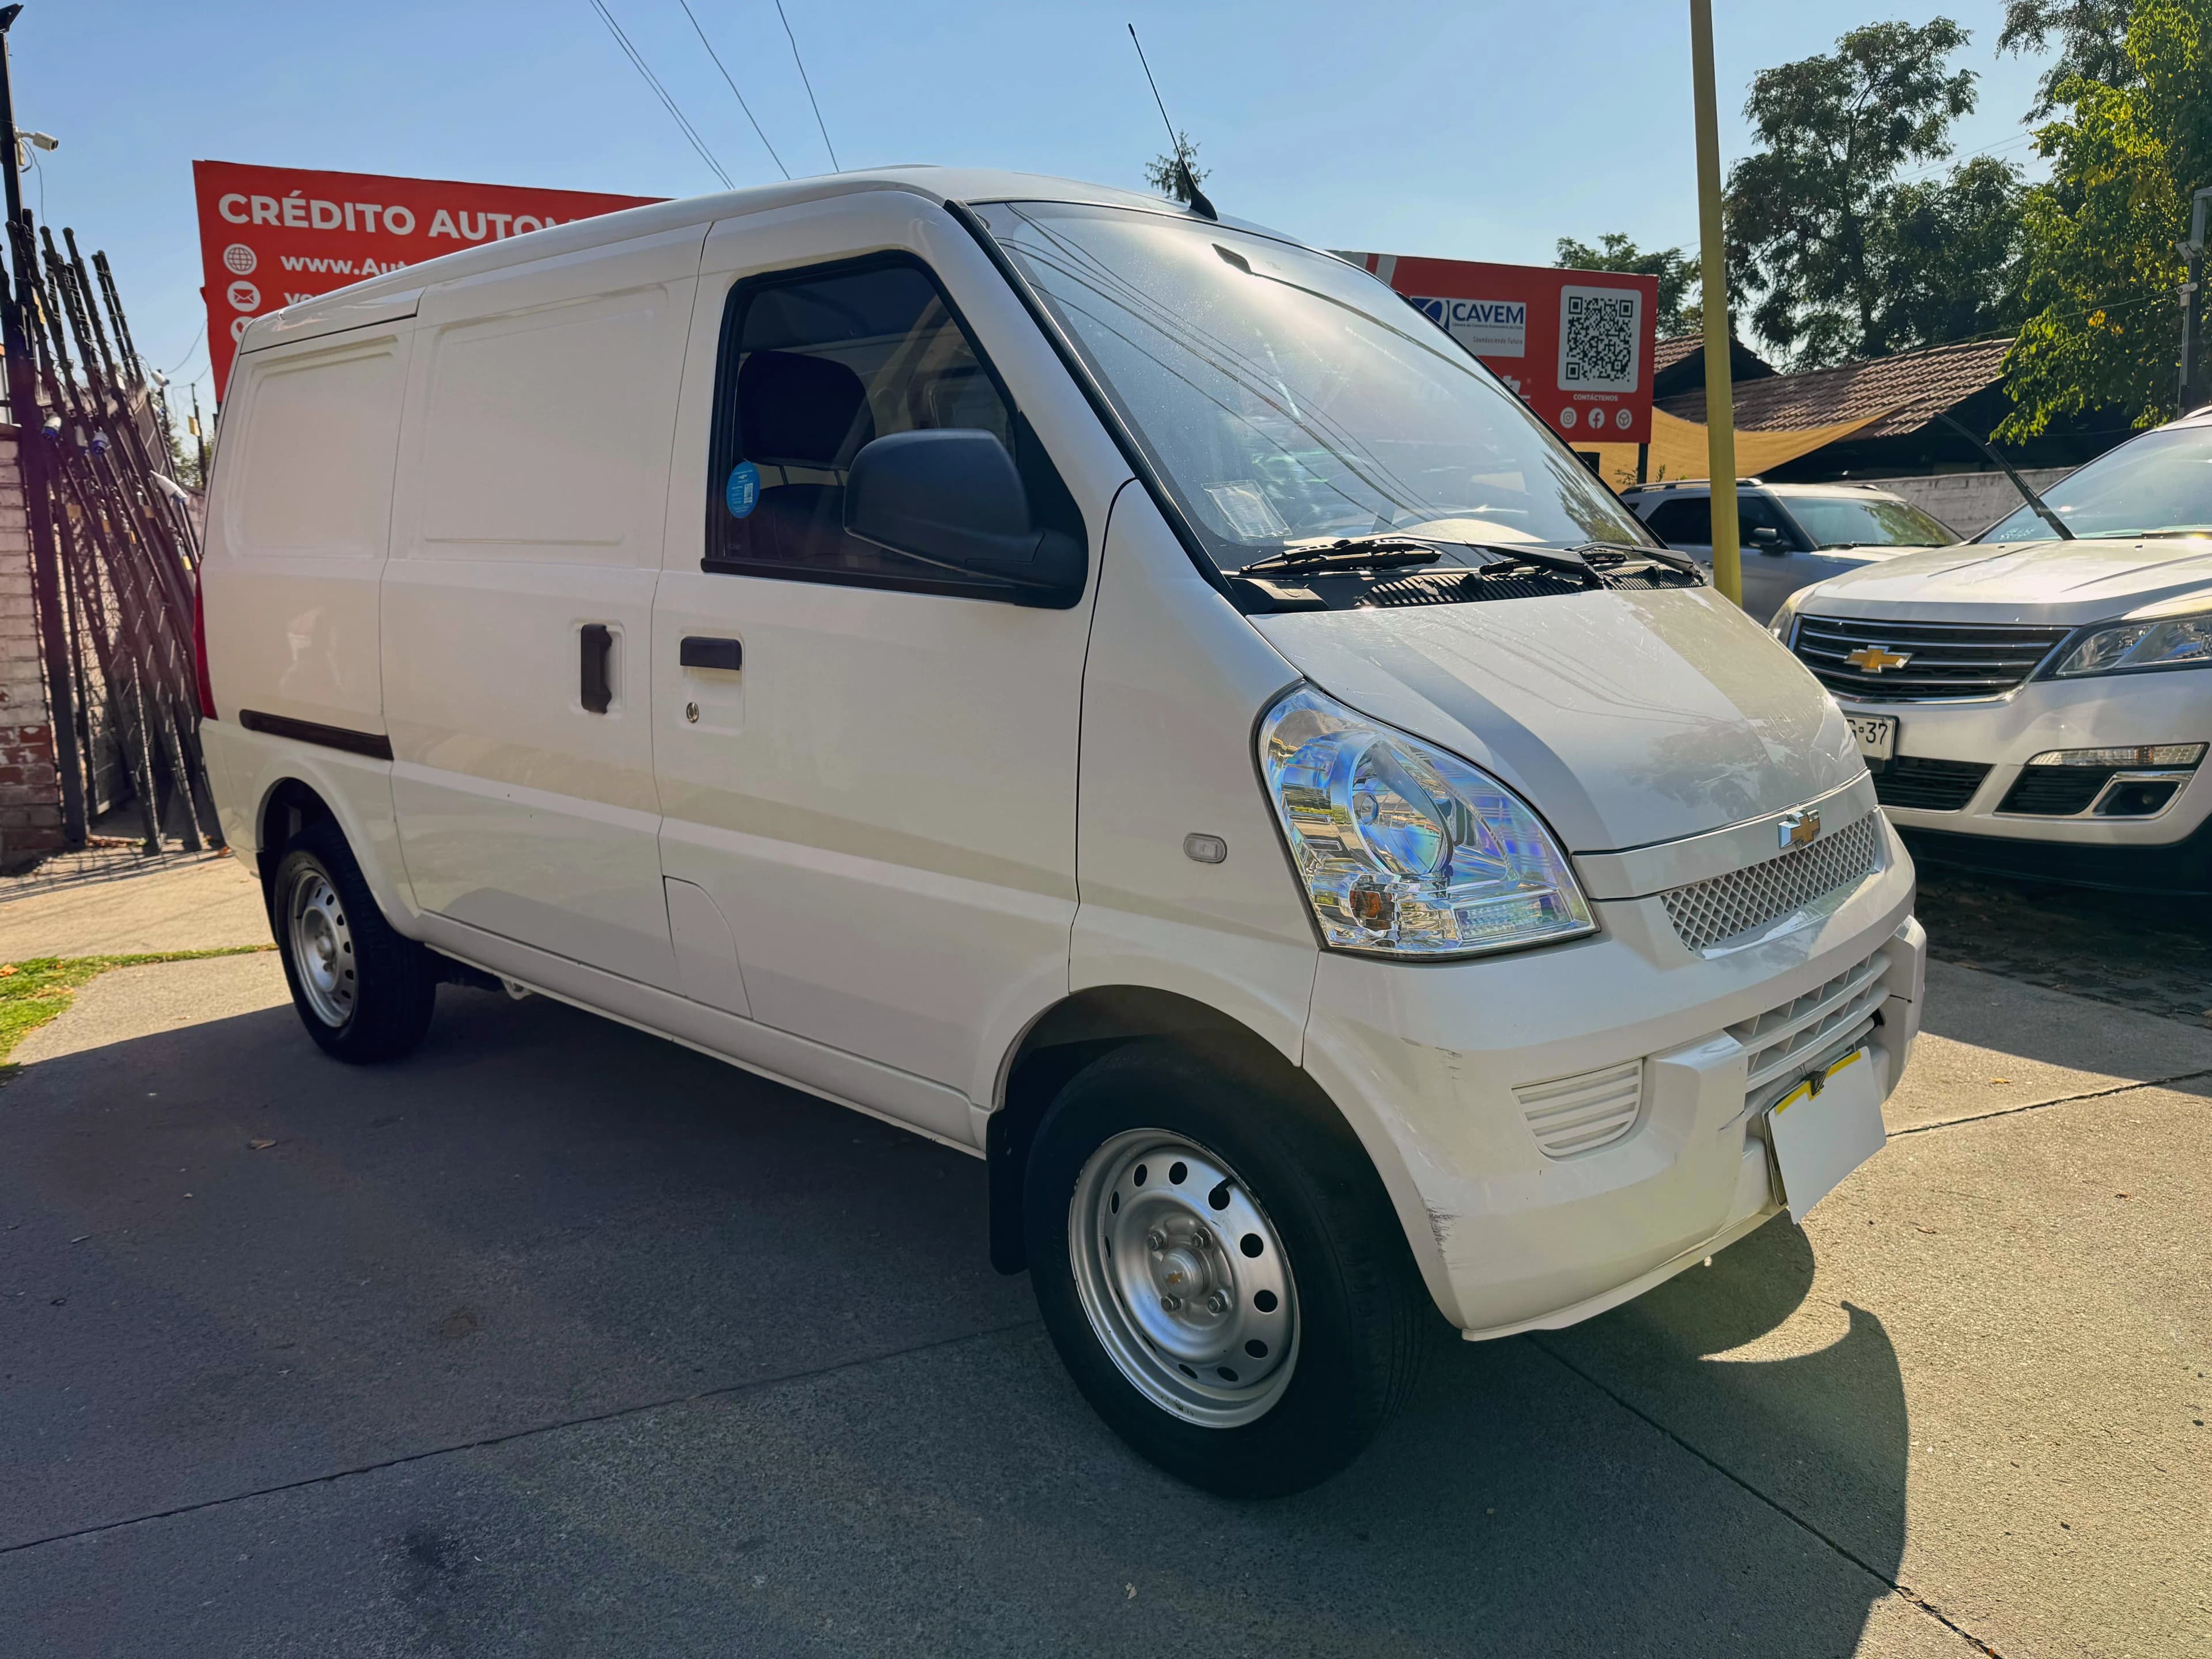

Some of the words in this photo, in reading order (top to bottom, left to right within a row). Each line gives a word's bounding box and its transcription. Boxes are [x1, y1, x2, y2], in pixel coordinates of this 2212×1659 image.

[218, 190, 416, 236] CRÉDITO
[428, 209, 577, 240] AUTO
[1452, 303, 1524, 324] CAVEM
